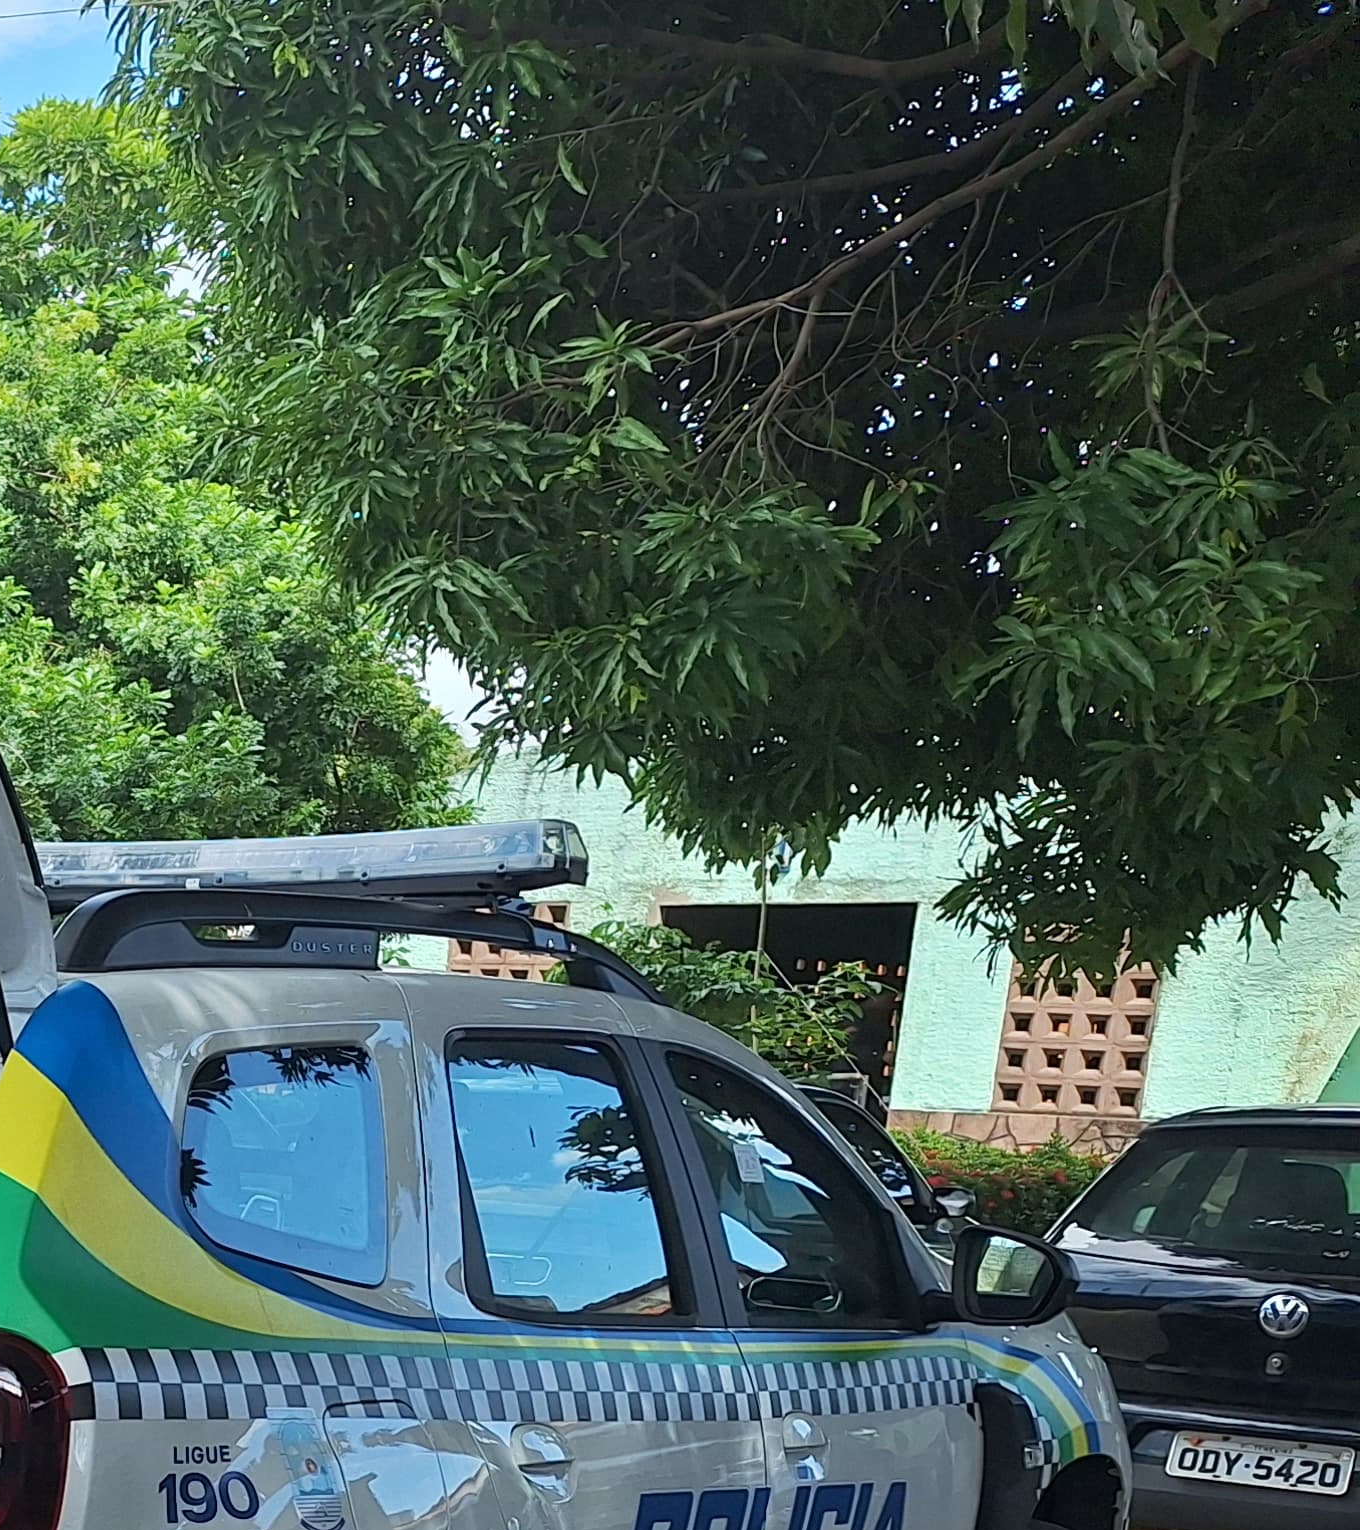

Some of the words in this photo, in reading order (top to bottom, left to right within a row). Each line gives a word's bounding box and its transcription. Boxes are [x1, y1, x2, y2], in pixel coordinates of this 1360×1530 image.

[292, 941, 373, 954] DUSTER
[173, 1445, 232, 1465] LIGUE
[158, 1470, 260, 1524] 190
